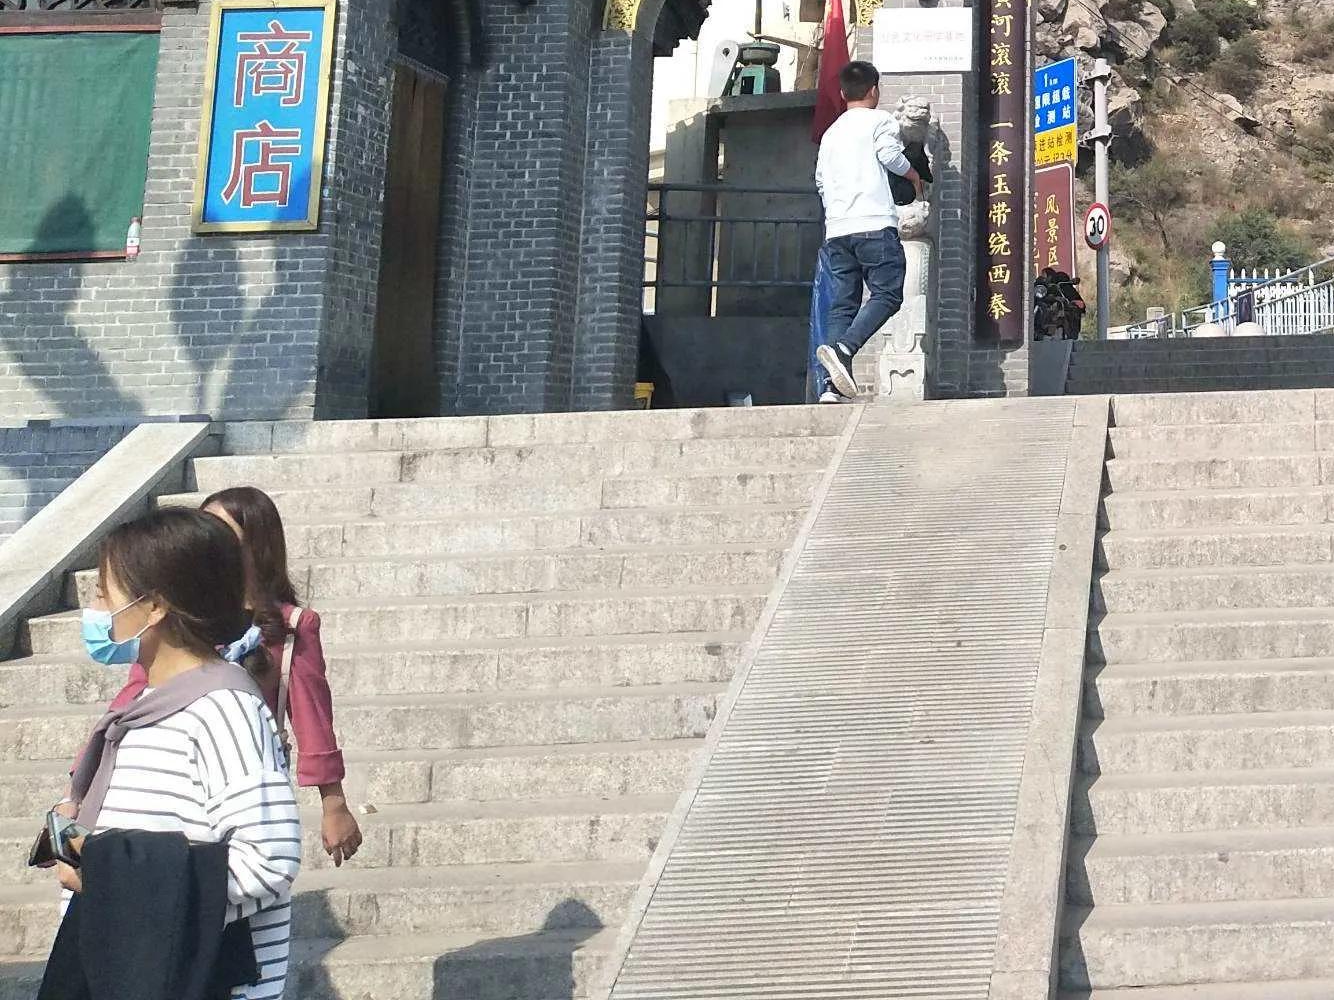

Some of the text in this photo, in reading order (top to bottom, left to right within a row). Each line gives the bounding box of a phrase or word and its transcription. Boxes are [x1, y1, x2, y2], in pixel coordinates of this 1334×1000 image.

[220, 19, 313, 209] 商店
[1044, 194, 1060, 266] 风景区
[1089, 214, 1105, 237] 30
